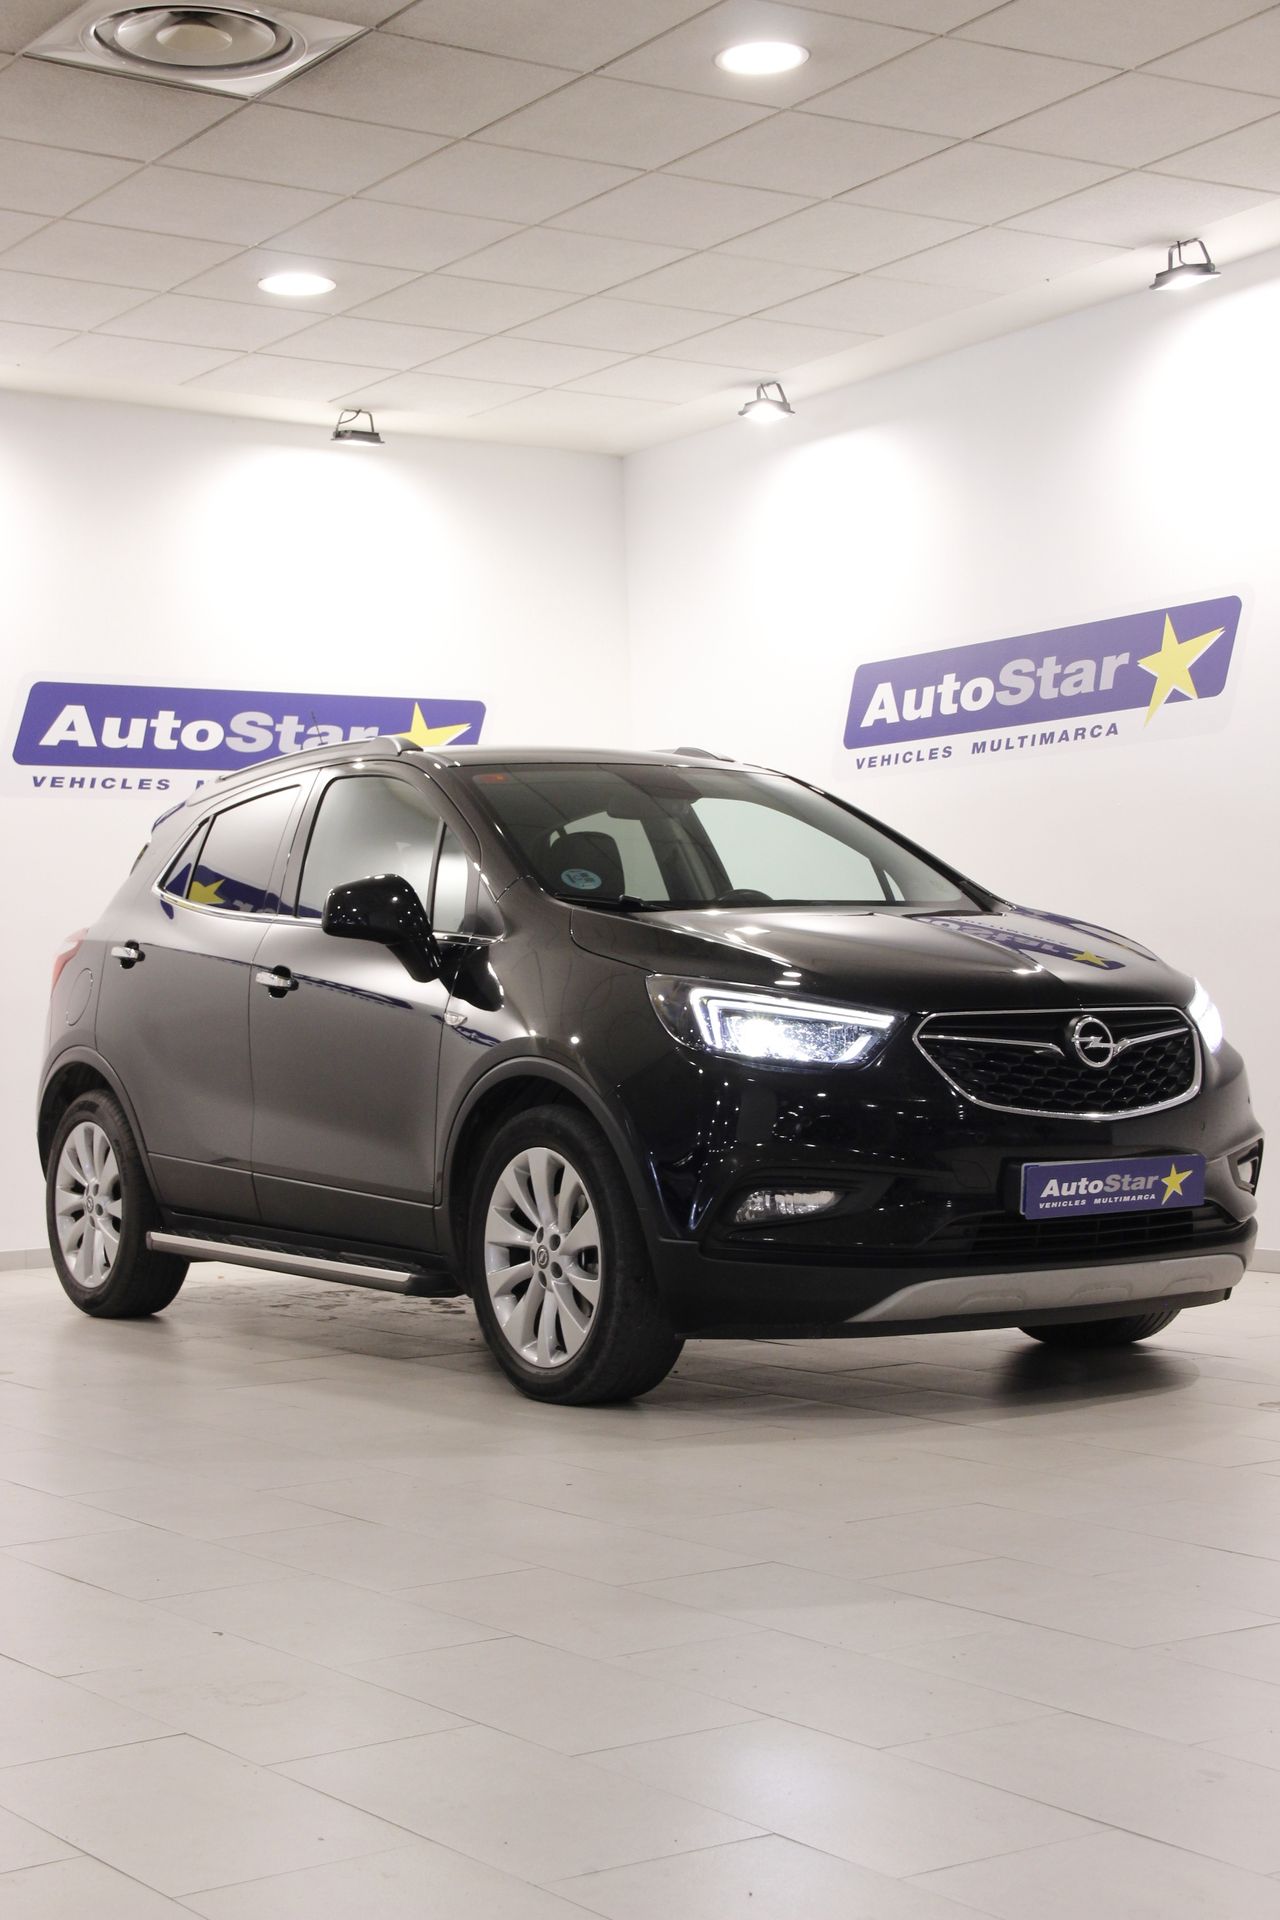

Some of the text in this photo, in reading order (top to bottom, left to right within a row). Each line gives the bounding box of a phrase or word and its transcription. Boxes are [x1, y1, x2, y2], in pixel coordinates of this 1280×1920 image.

[860, 652, 1130, 728] AutoStar
[856, 722, 1119, 770] VEHICLES MULTIMARCA
[32, 775, 171, 791] VEHICLES
[1040, 1174, 1159, 1198] AutoStar
[1039, 1194, 1156, 1209] VEHICLES MULTIMARCA
